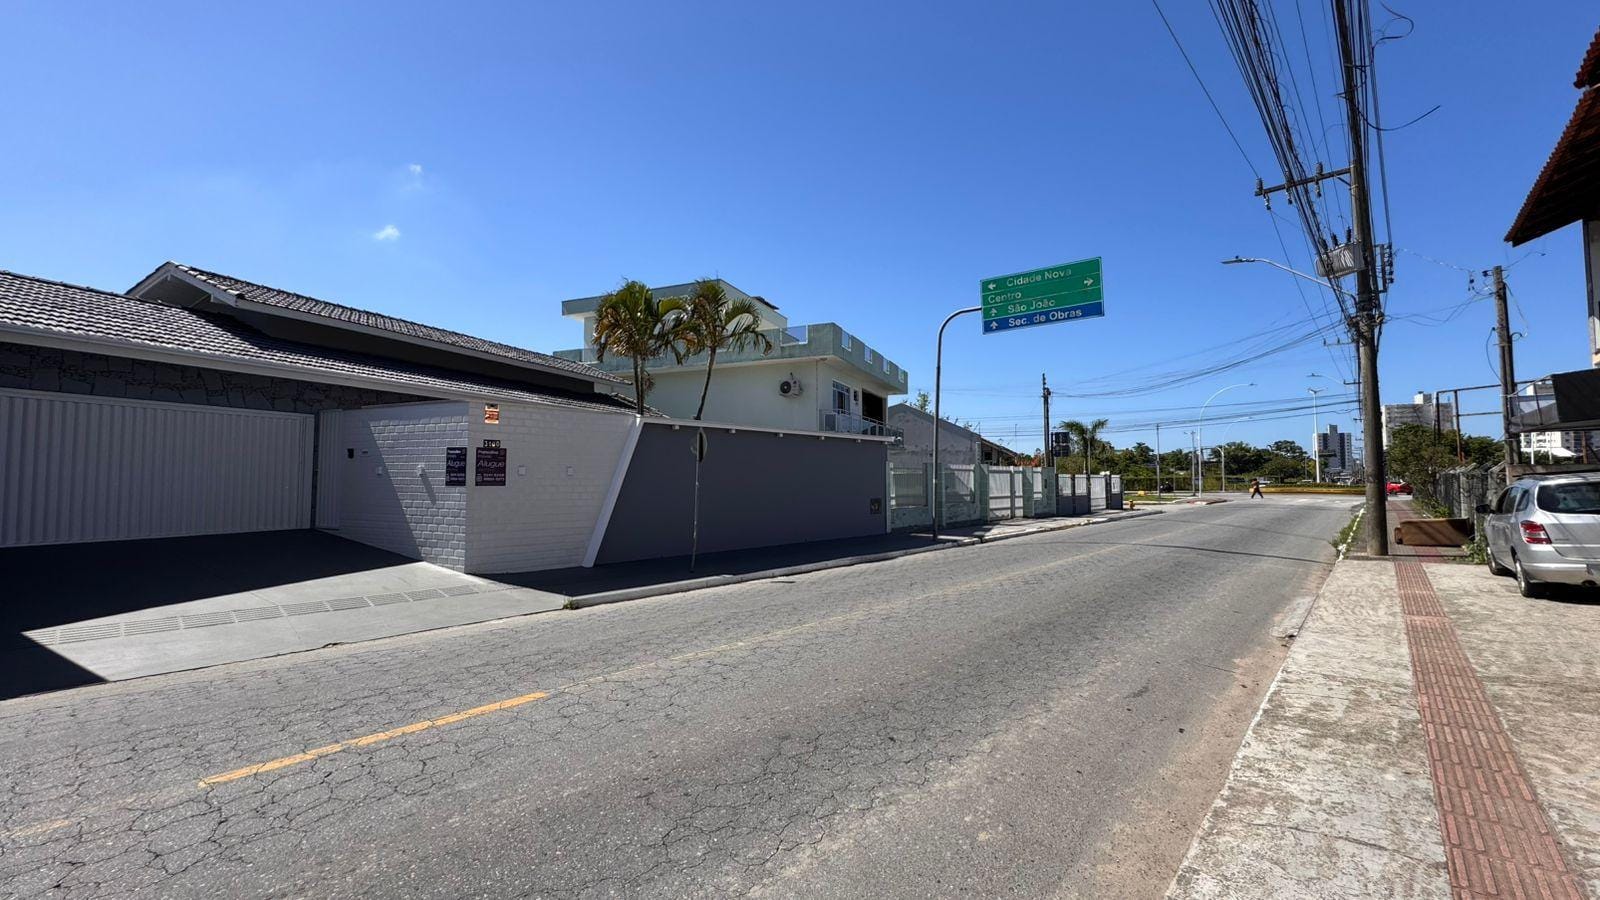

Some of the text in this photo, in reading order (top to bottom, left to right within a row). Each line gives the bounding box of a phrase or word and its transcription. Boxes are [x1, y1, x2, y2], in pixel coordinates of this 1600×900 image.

[1006, 268, 1072, 287] Cidade Nova
[988, 291, 1022, 303] Centro
[1007, 299, 1056, 314] São João
[1008, 309, 1083, 327] Sec. de Obras
[477, 460, 505, 468] Alugue
